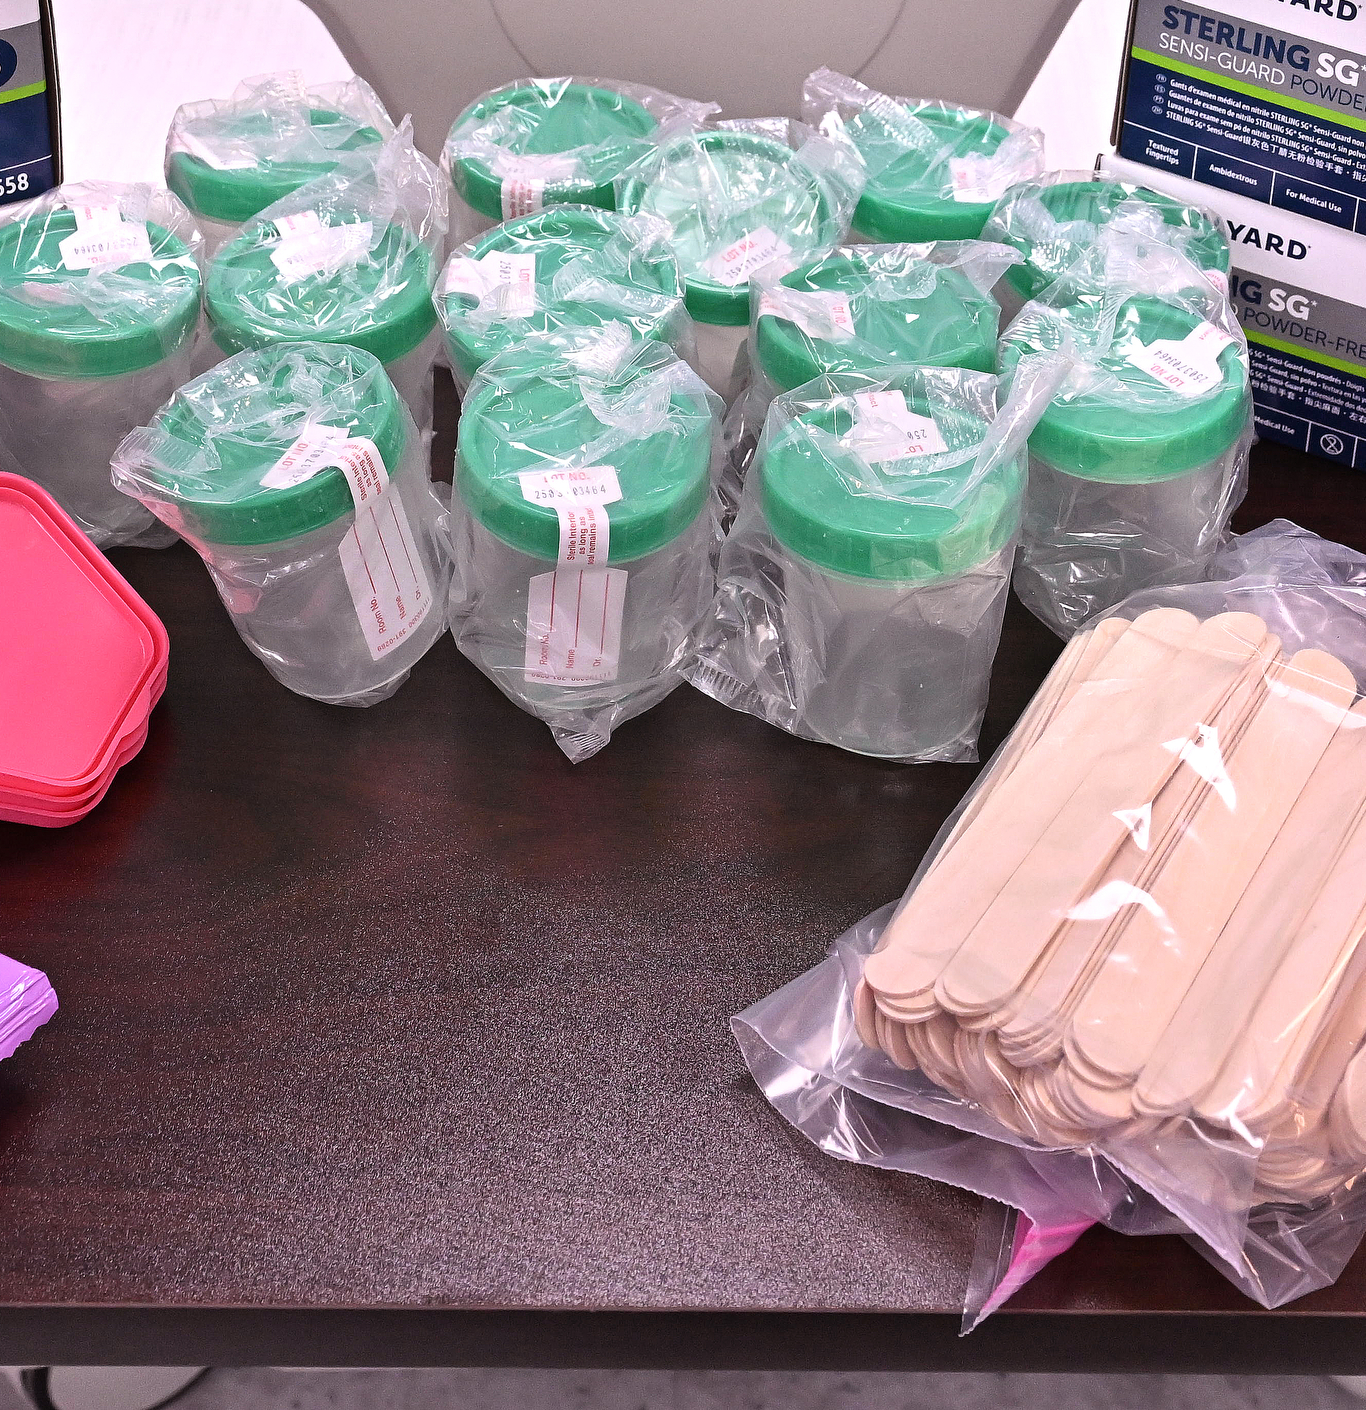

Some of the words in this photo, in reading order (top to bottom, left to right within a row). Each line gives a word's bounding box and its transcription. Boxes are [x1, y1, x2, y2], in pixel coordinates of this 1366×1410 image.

[1161, 5, 1311, 72] STERLING
[1159, 32, 1285, 86] SENSI-GUARD
[1145, 148, 1179, 166] Fingertips
[1148, 140, 1179, 158] Textured
[1209, 164, 1258, 187] Ambidextrous
[1286, 188, 1299, 199] For
[1299, 192, 1327, 208] Medical
[1327, 202, 1342, 214] Use
[1164, 374, 1185, 388] LOT
[396, 596, 406, 620] Name
